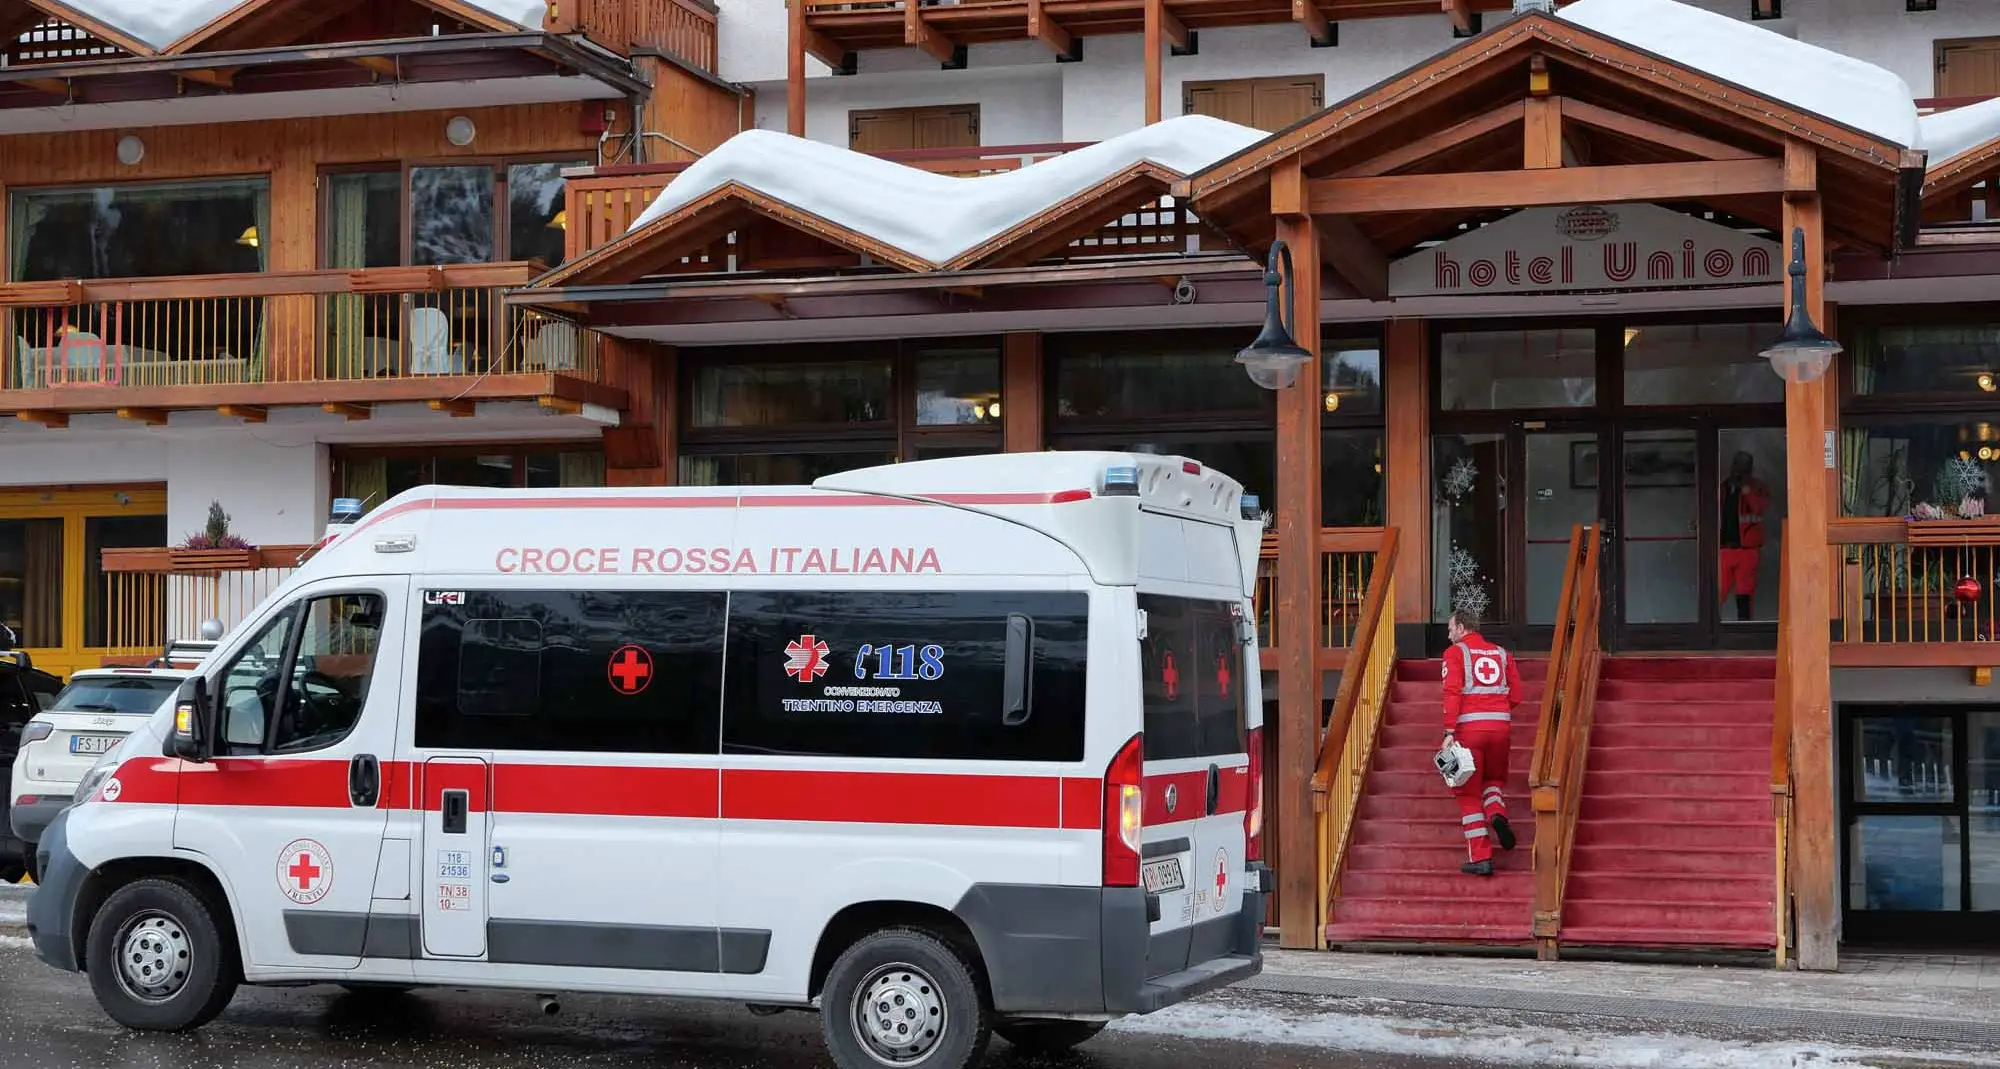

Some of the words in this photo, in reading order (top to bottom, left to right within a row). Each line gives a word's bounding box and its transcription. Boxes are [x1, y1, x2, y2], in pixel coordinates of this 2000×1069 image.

[1435, 246, 1573, 289] hotel
[1604, 239, 1770, 282] Union
[495, 547, 619, 573] CROCE
[632, 547, 757, 573] ROSSA
[769, 547, 942, 573] ITALIANA
[873, 644, 945, 681] 118
[824, 686, 900, 697] CONVENZIONATO
[782, 699, 854, 712] TRENTINO
[857, 701, 942, 714] EMERGENZA
[78, 737, 92, 750] FS
[448, 853, 462, 863] 118
[441, 865, 468, 876] 21536
[287, 888, 324, 901] TRENTO
[440, 886, 453, 896] TN
[456, 887, 467, 897] 38
